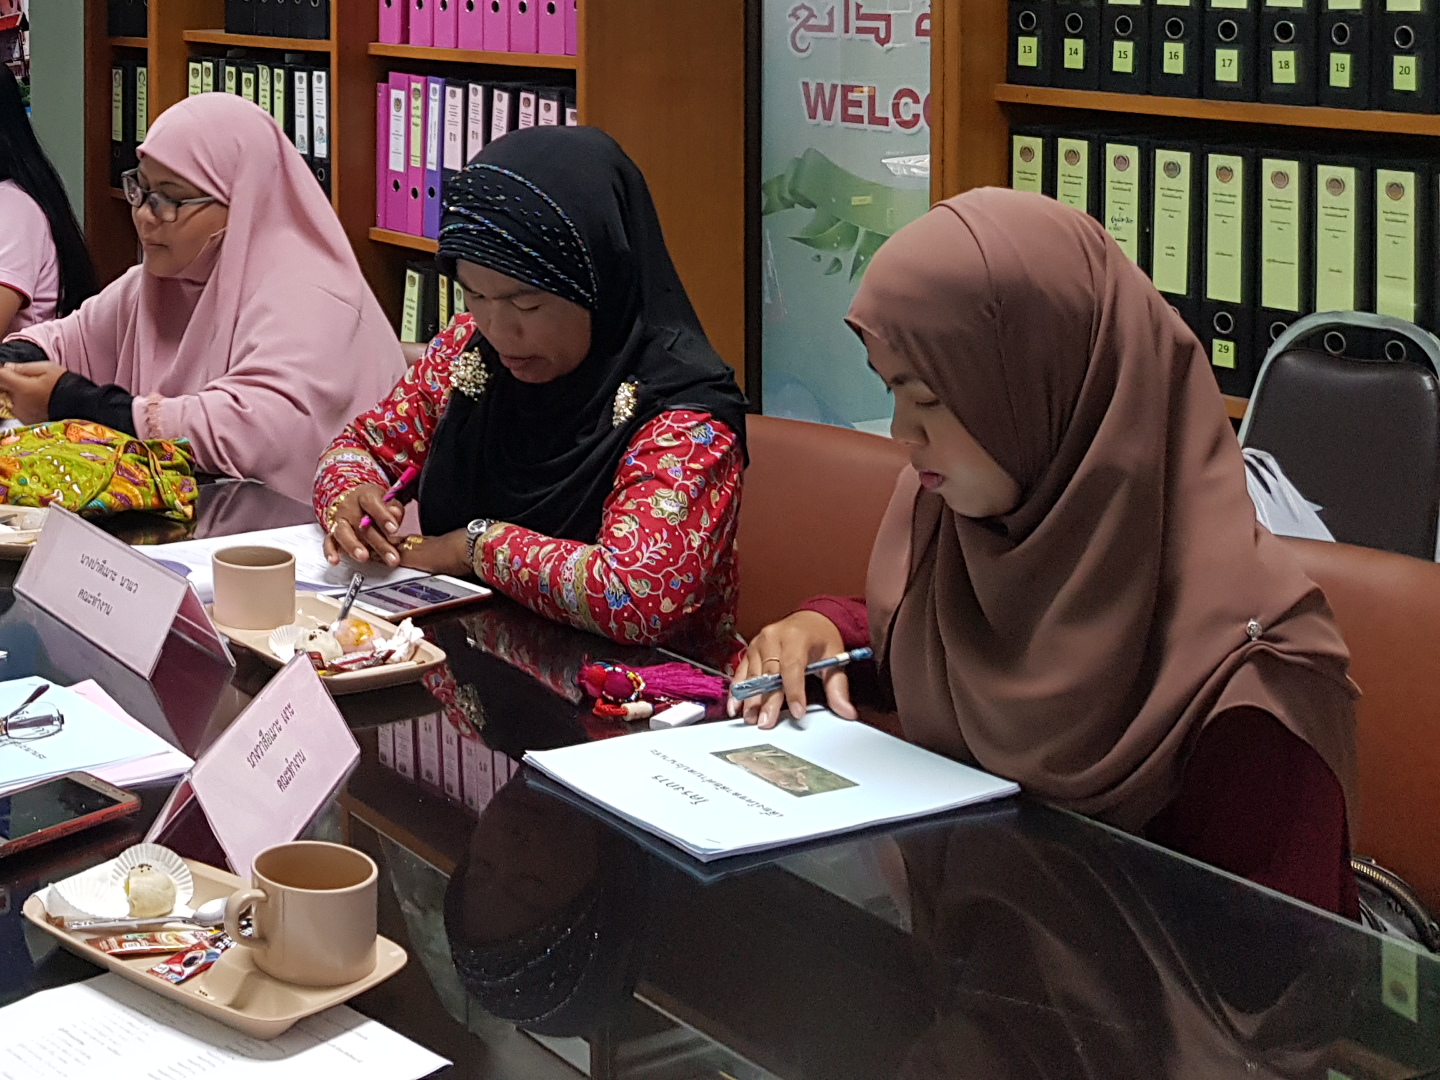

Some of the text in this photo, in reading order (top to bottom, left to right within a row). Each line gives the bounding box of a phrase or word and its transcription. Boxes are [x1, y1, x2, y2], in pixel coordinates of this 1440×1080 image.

[1021, 44, 1034, 55] 13
[1068, 46, 1080, 57] 14
[1116, 49, 1129, 61] 15
[1167, 50, 1181, 61] 16
[1221, 57, 1234, 69] 17
[1277, 59, 1291, 71] 18
[1334, 61, 1347, 73] 19
[1397, 64, 1412, 77] 20
[1218, 343, 1230, 354] 29
[276, 750, 306, 794] คณะทำงาน
